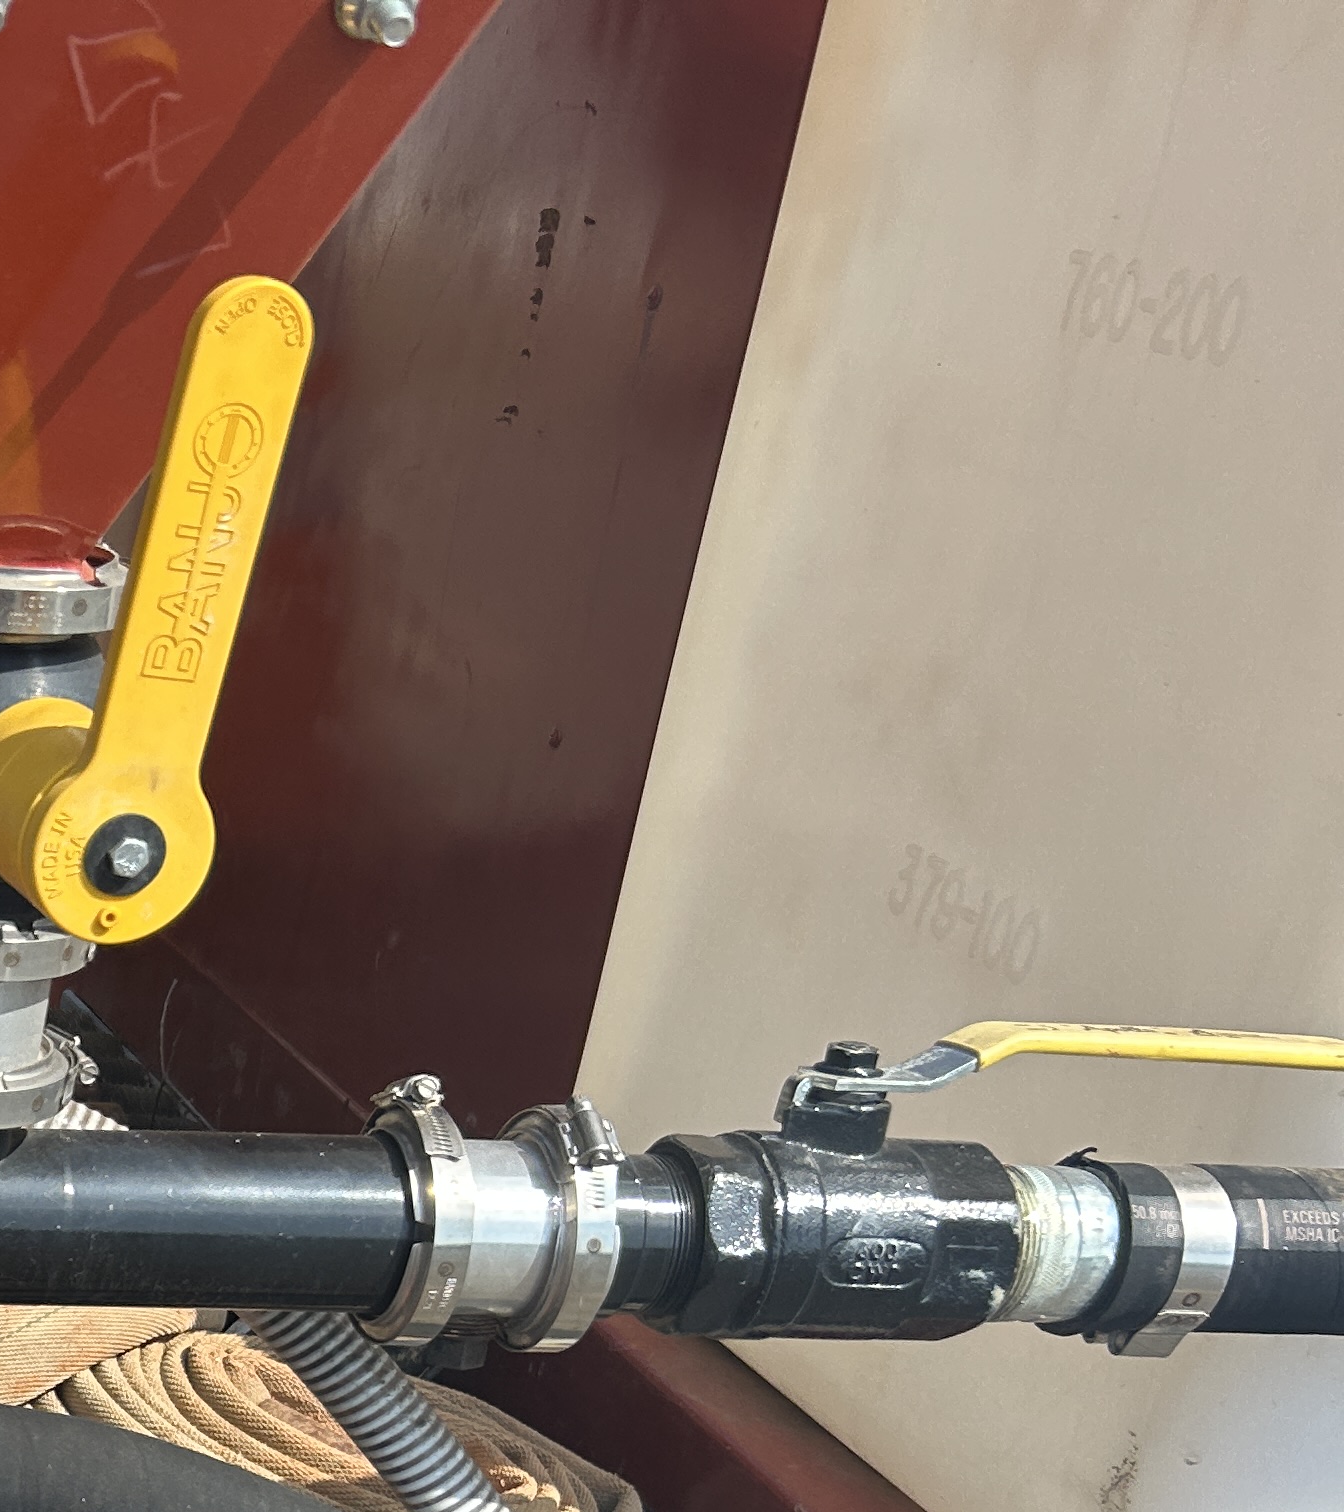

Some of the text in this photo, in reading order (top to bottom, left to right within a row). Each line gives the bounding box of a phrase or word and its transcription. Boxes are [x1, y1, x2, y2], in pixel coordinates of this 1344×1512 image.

[215, 296, 257, 336] OPEN
[1058, 249, 1251, 368] 760-200
[140, 402, 264, 683] BANJO
[42, 812, 73, 900] MADE IN
[65, 836, 86, 878] USA
[1283, 1208, 1341, 1225] EXCEEDS
[1285, 1227, 1324, 1243] MSHA
